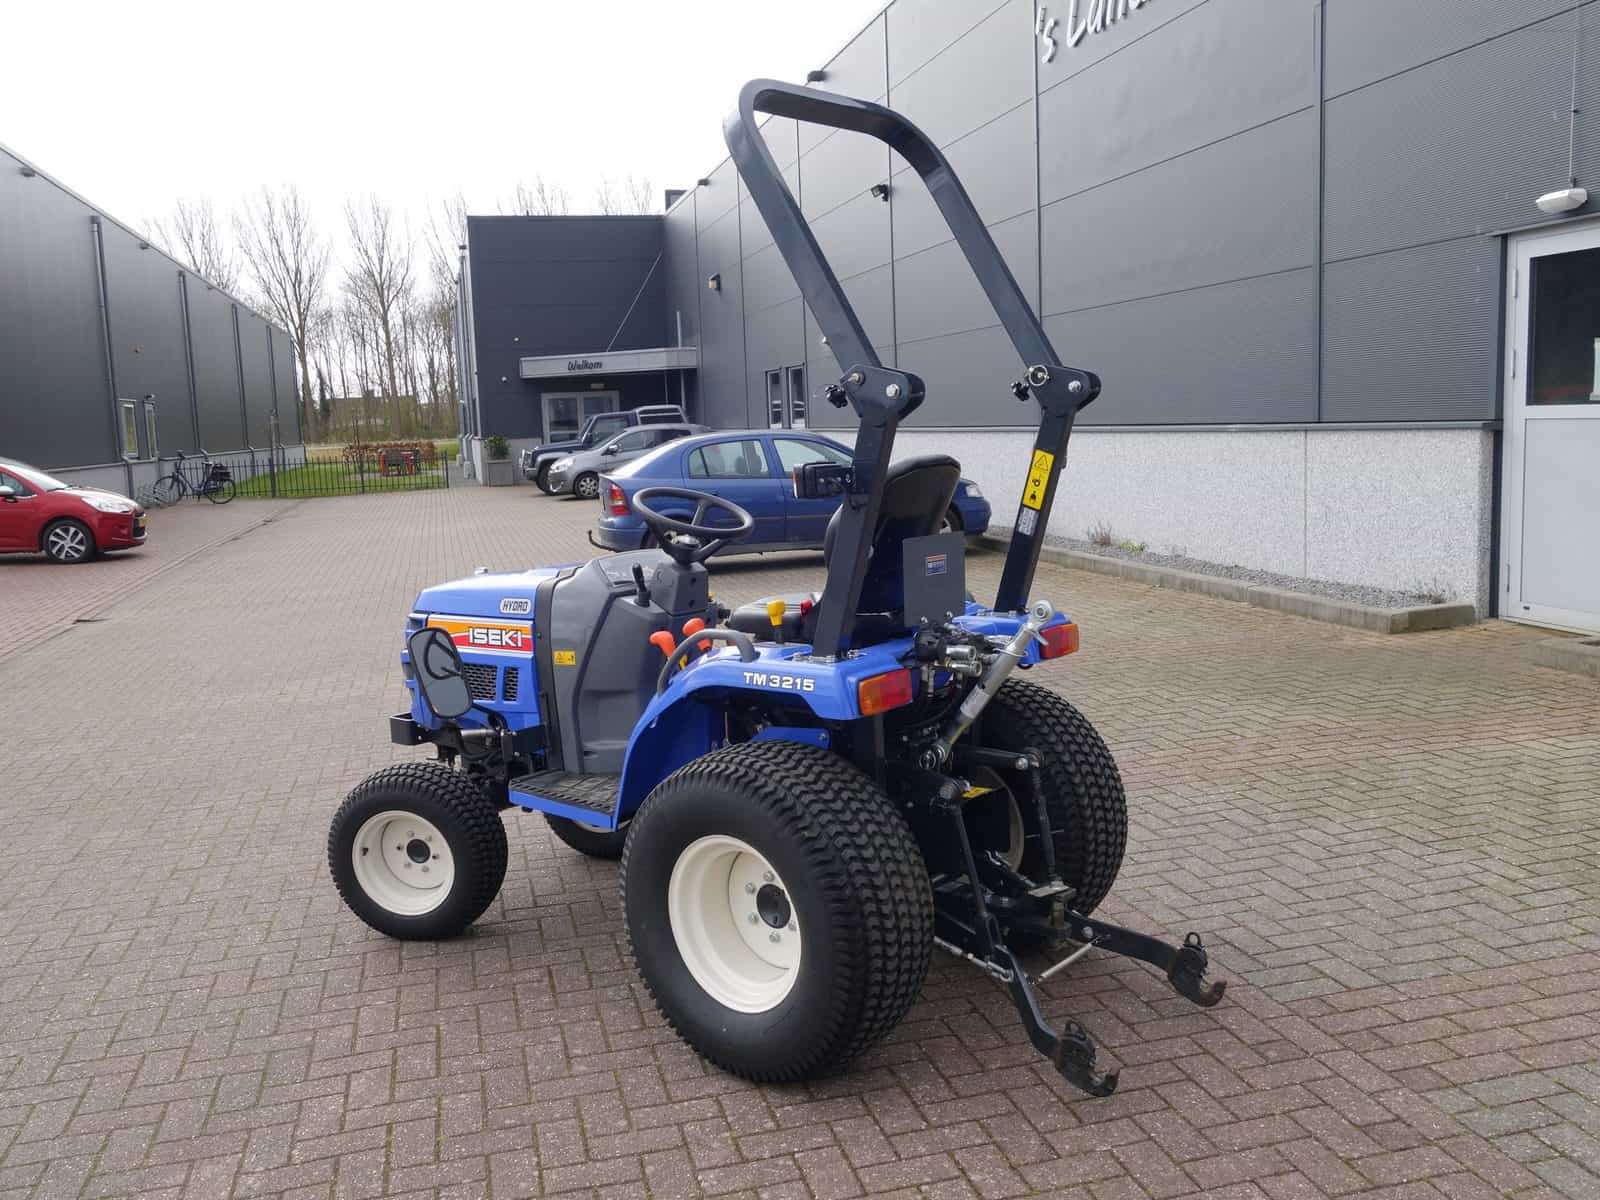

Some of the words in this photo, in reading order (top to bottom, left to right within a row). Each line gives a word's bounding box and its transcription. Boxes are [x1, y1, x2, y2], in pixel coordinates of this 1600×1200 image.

[567, 359, 603, 371] Welkom
[502, 600, 529, 612] HYDRO
[468, 627, 523, 647] ISEKI
[743, 671, 767, 687] TM
[768, 674, 816, 692] 3215
